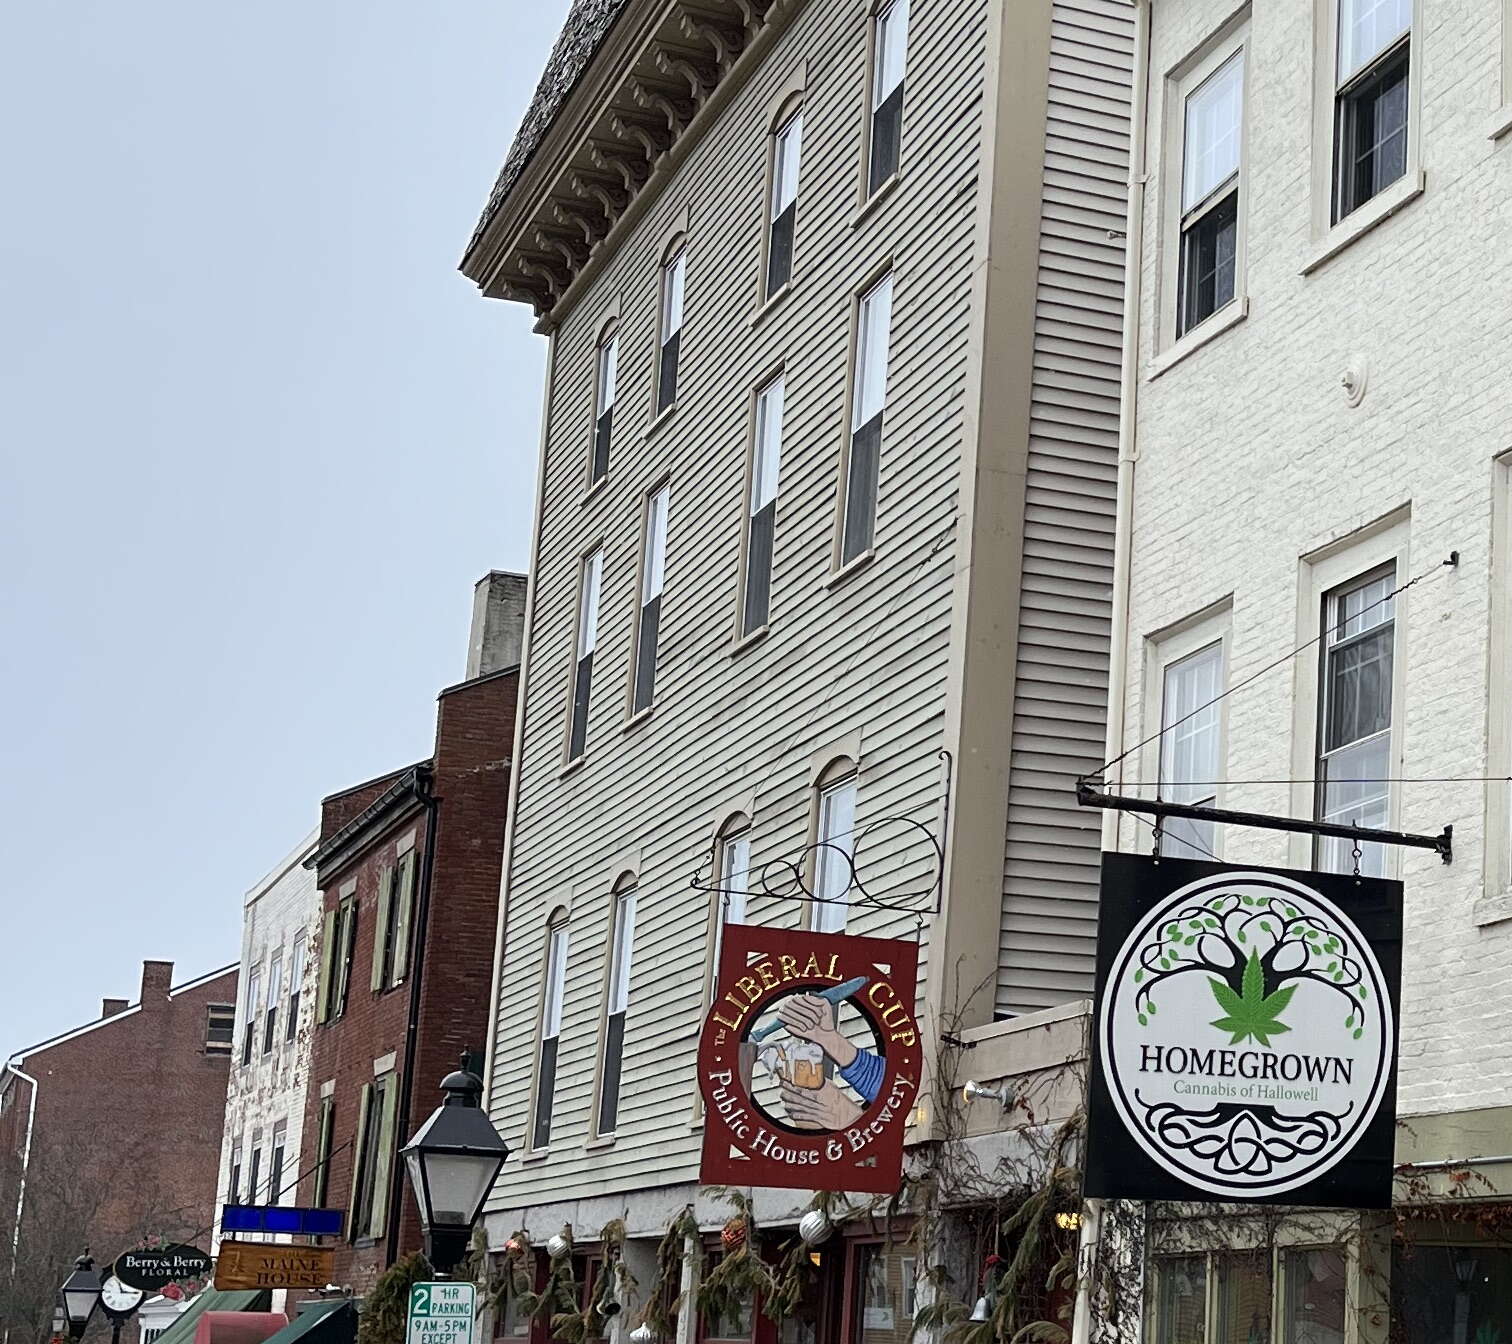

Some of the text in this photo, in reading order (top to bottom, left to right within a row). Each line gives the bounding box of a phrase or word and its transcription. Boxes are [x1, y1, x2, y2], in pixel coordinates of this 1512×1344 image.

[713, 951, 916, 1047] The LIBERAL CUP
[1139, 1044, 1354, 1084] HOMEGROWN
[1173, 1080, 1319, 1102] Cannabis of Hallowell
[709, 1069, 915, 1165] Public House & Brewery
[126, 1255, 207, 1270] Berry & Berry
[141, 1267, 190, 1276] FLORAL
[261, 1257, 321, 1271] MAINE
[257, 1272, 323, 1285] HOUSE
[412, 1288, 430, 1314] 2
[432, 1302, 470, 1315] PARKING
